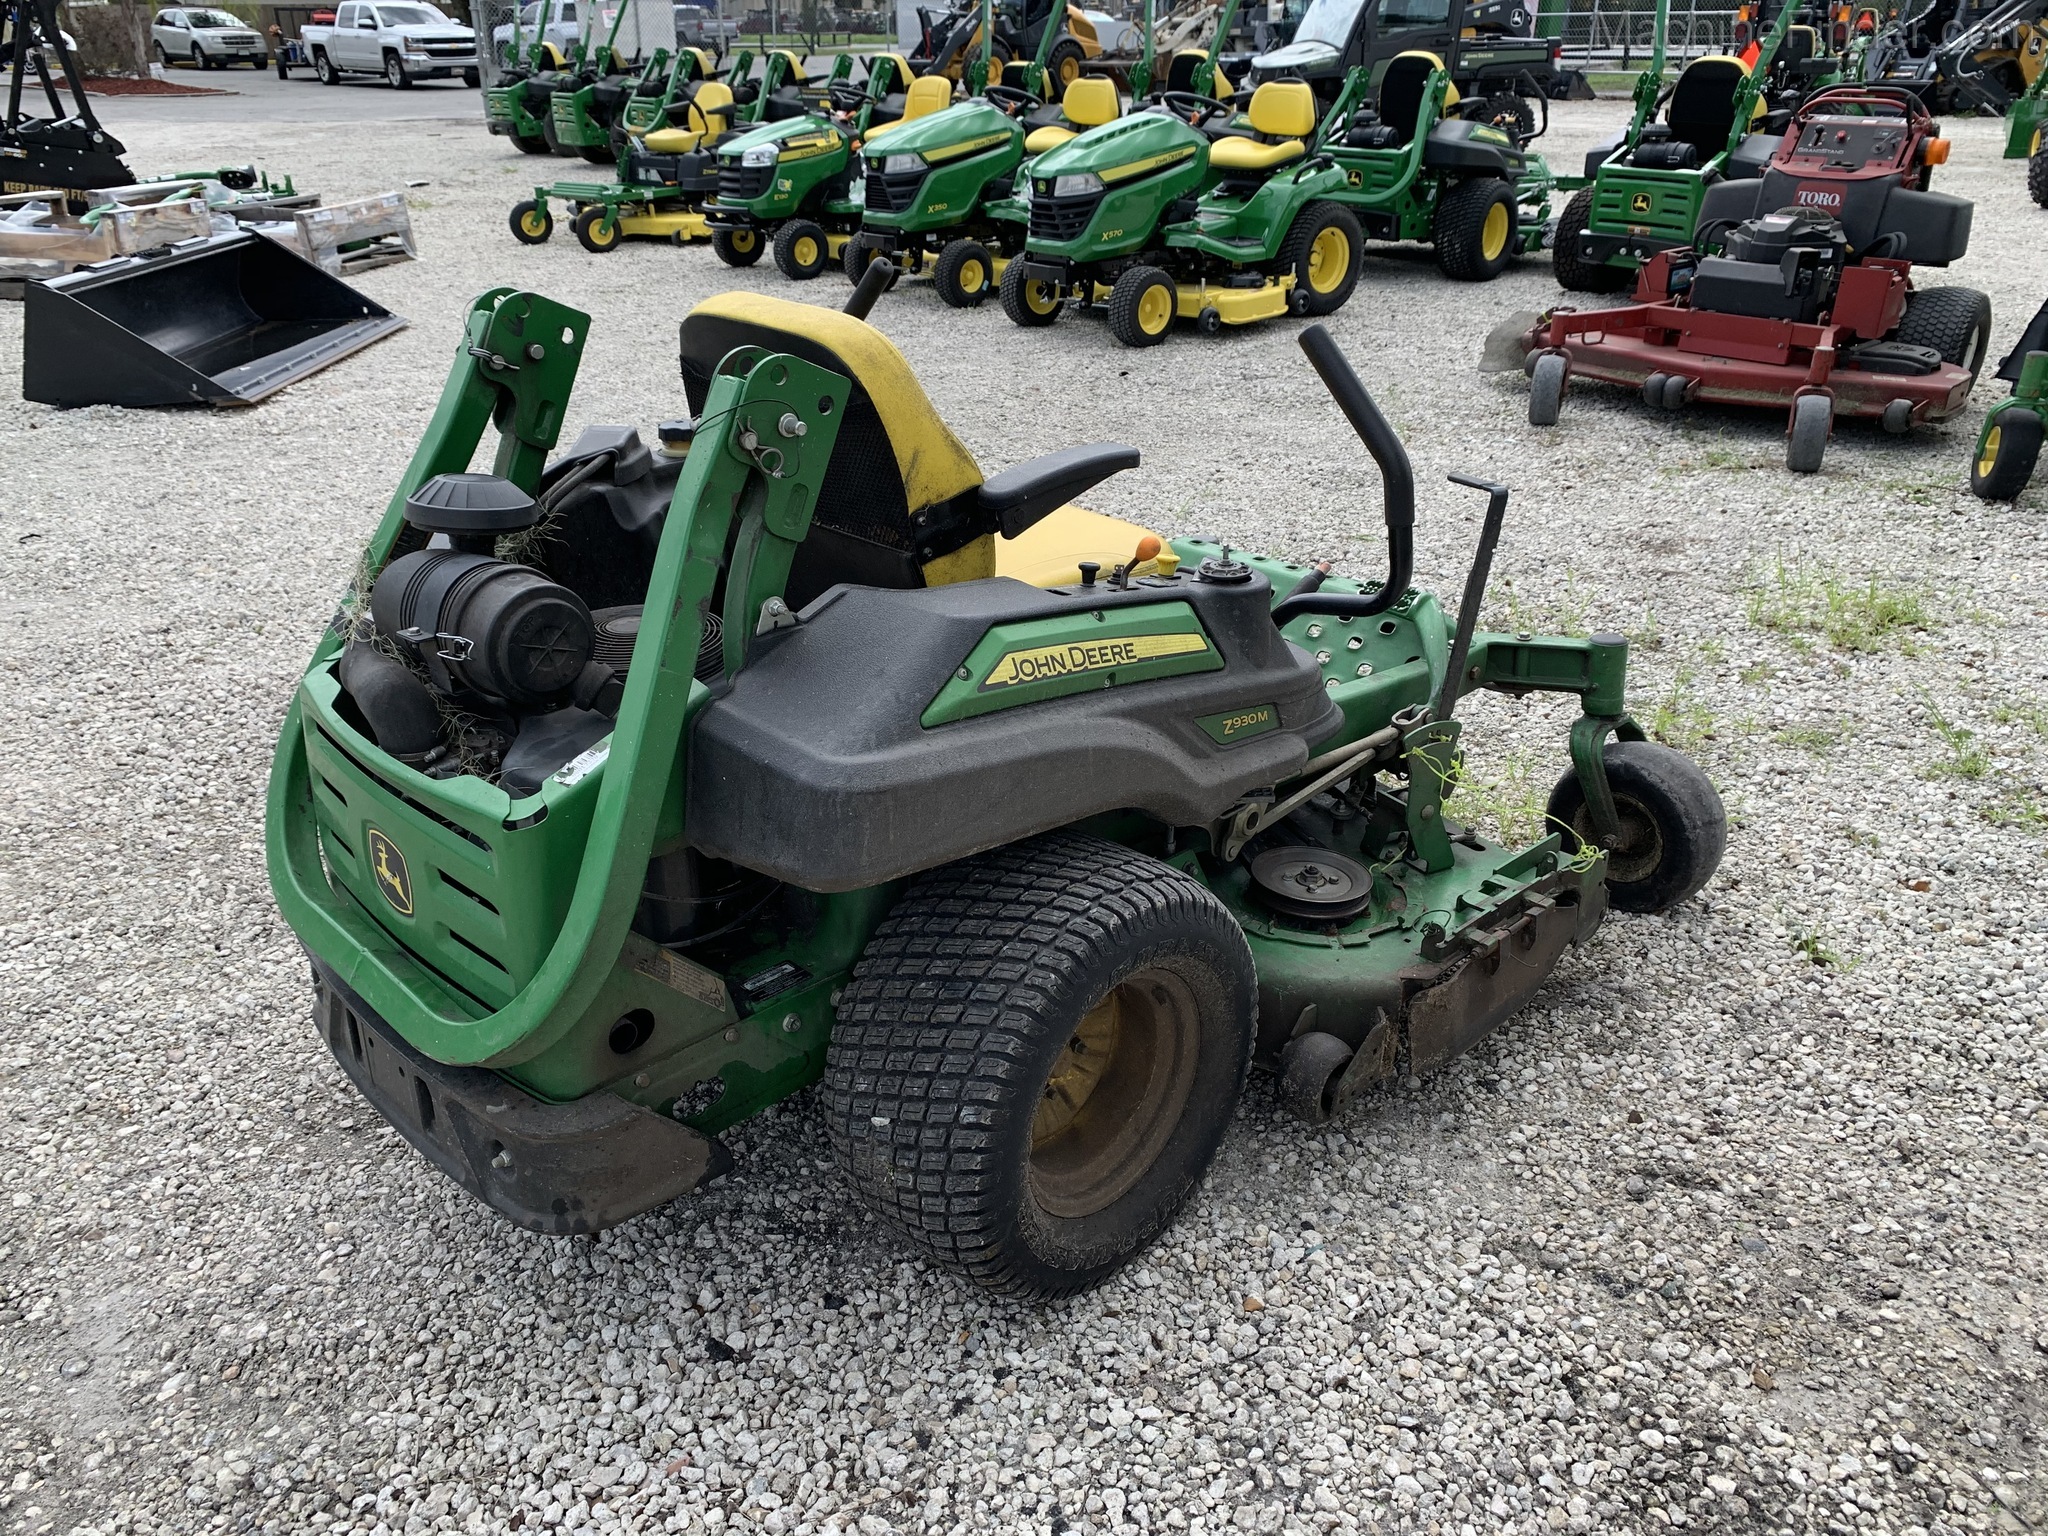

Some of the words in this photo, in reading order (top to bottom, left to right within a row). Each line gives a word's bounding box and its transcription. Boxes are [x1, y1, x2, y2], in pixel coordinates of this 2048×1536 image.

[4, 181, 26, 193] KEEP
[1798, 191, 1840, 206] TORO
[927, 203, 948, 214] X350
[1101, 229, 1123, 241] X570
[1009, 652, 1067, 681] JOHN
[1067, 642, 1137, 669] DEERE
